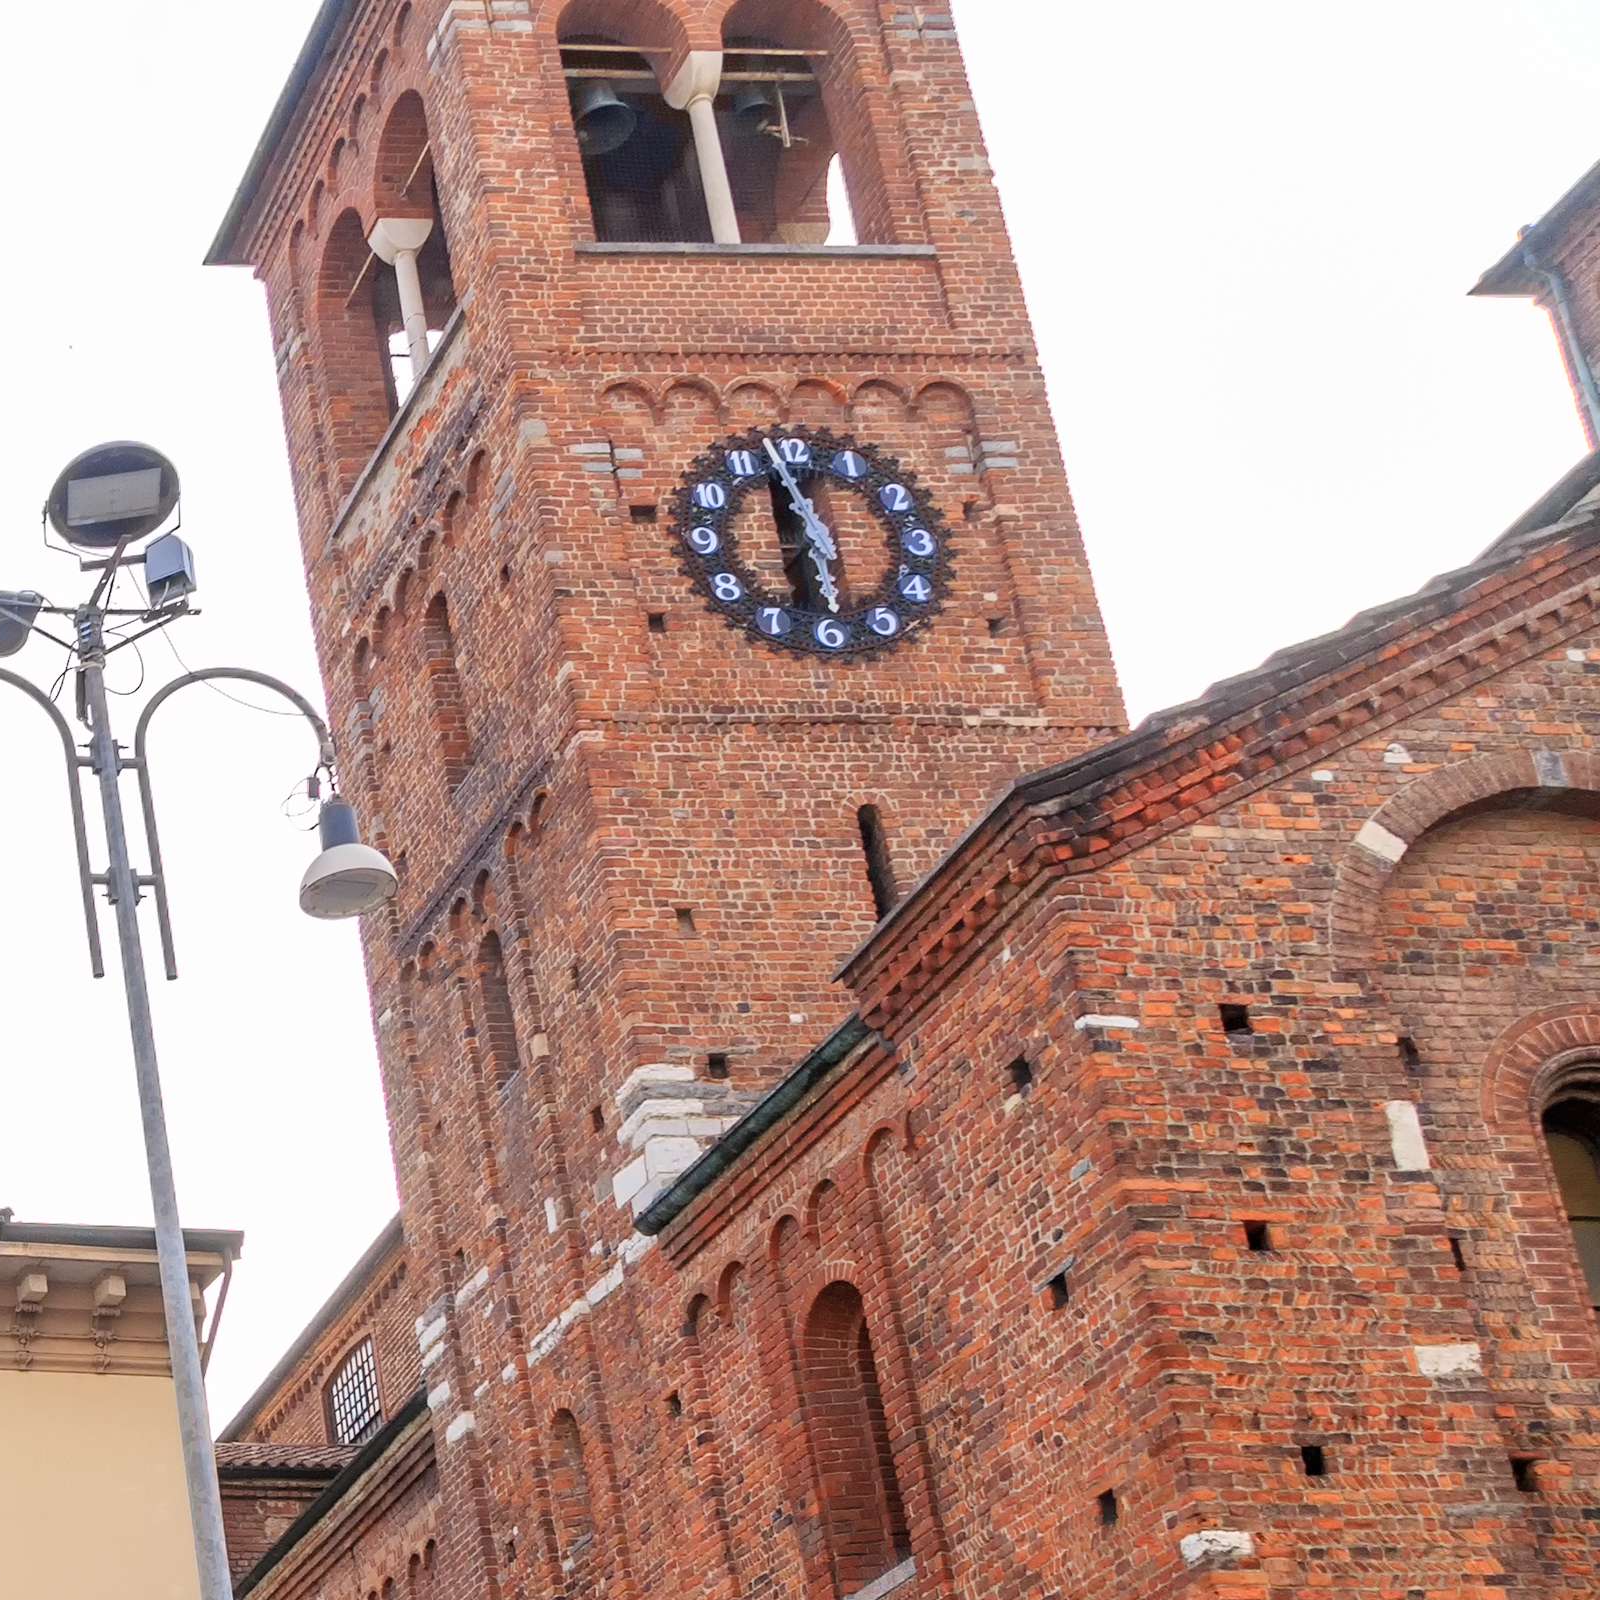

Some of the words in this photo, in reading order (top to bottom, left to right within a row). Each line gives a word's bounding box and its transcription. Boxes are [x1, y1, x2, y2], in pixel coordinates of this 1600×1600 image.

[729, 450, 752, 476] 11
[779, 437, 809, 464] 12
[843, 450, 859, 477] 1
[696, 482, 725, 510] 10
[884, 483, 910, 512] 2
[691, 527, 718, 555] 9
[907, 531, 935, 556] 3
[714, 573, 741, 601] 8
[901, 574, 932, 600] 4
[762, 607, 782, 635] 7
[816, 619, 844, 648] 6
[874, 607, 898, 636] 5
